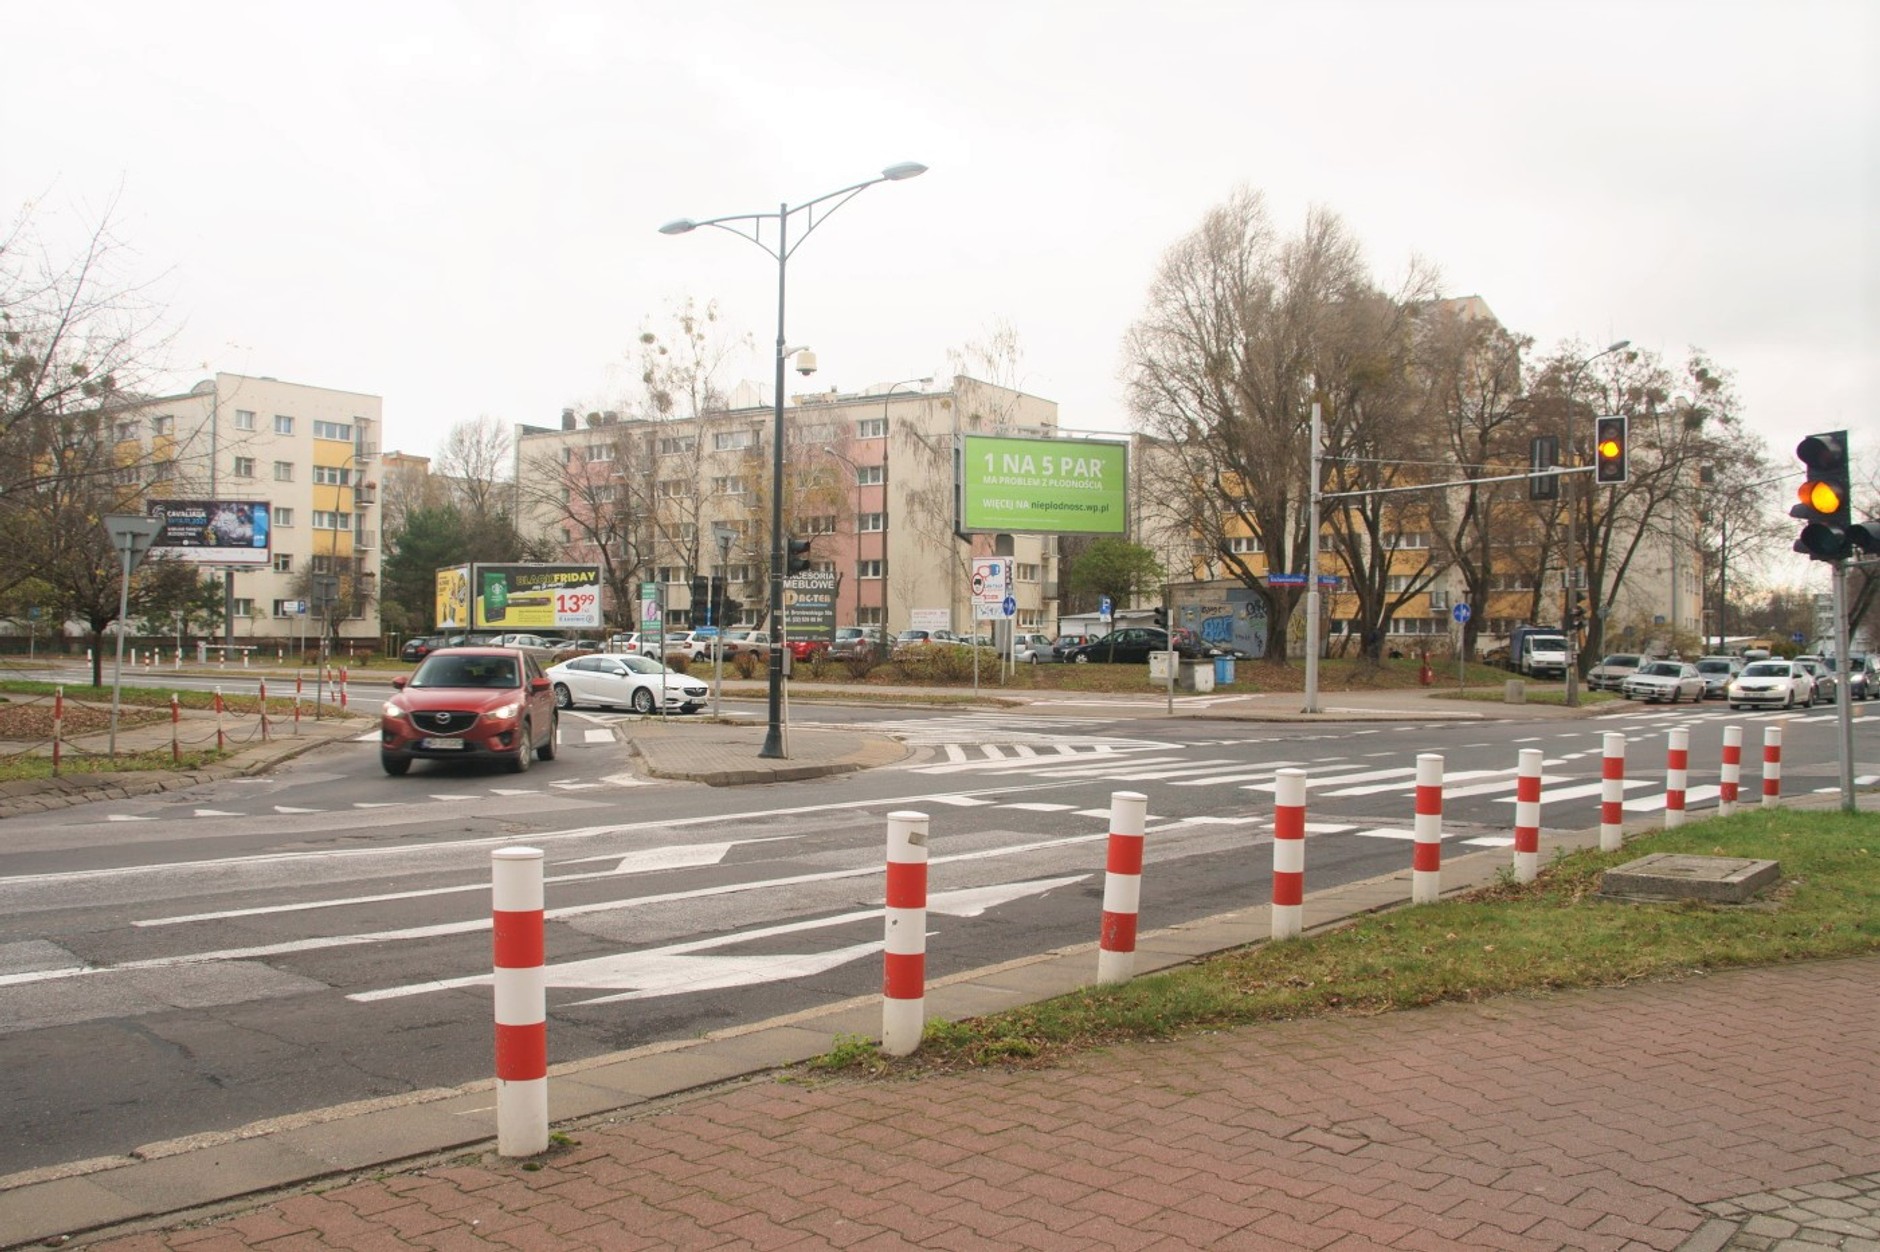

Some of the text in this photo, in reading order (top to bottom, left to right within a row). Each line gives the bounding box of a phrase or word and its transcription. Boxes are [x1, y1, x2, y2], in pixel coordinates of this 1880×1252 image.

[984, 452, 995, 473] 1
[1003, 453, 1037, 475] NA
[1042, 456, 1054, 475] 5
[983, 475, 998, 484] MA
[1000, 476, 1041, 487] PROBLEM
[1042, 478, 1048, 487] Z
[983, 498, 1014, 510] WIĘCEJ
[1016, 500, 1029, 509] NA
[554, 571, 595, 582] FRIDAY
[783, 580, 835, 589] MEBLOWE
